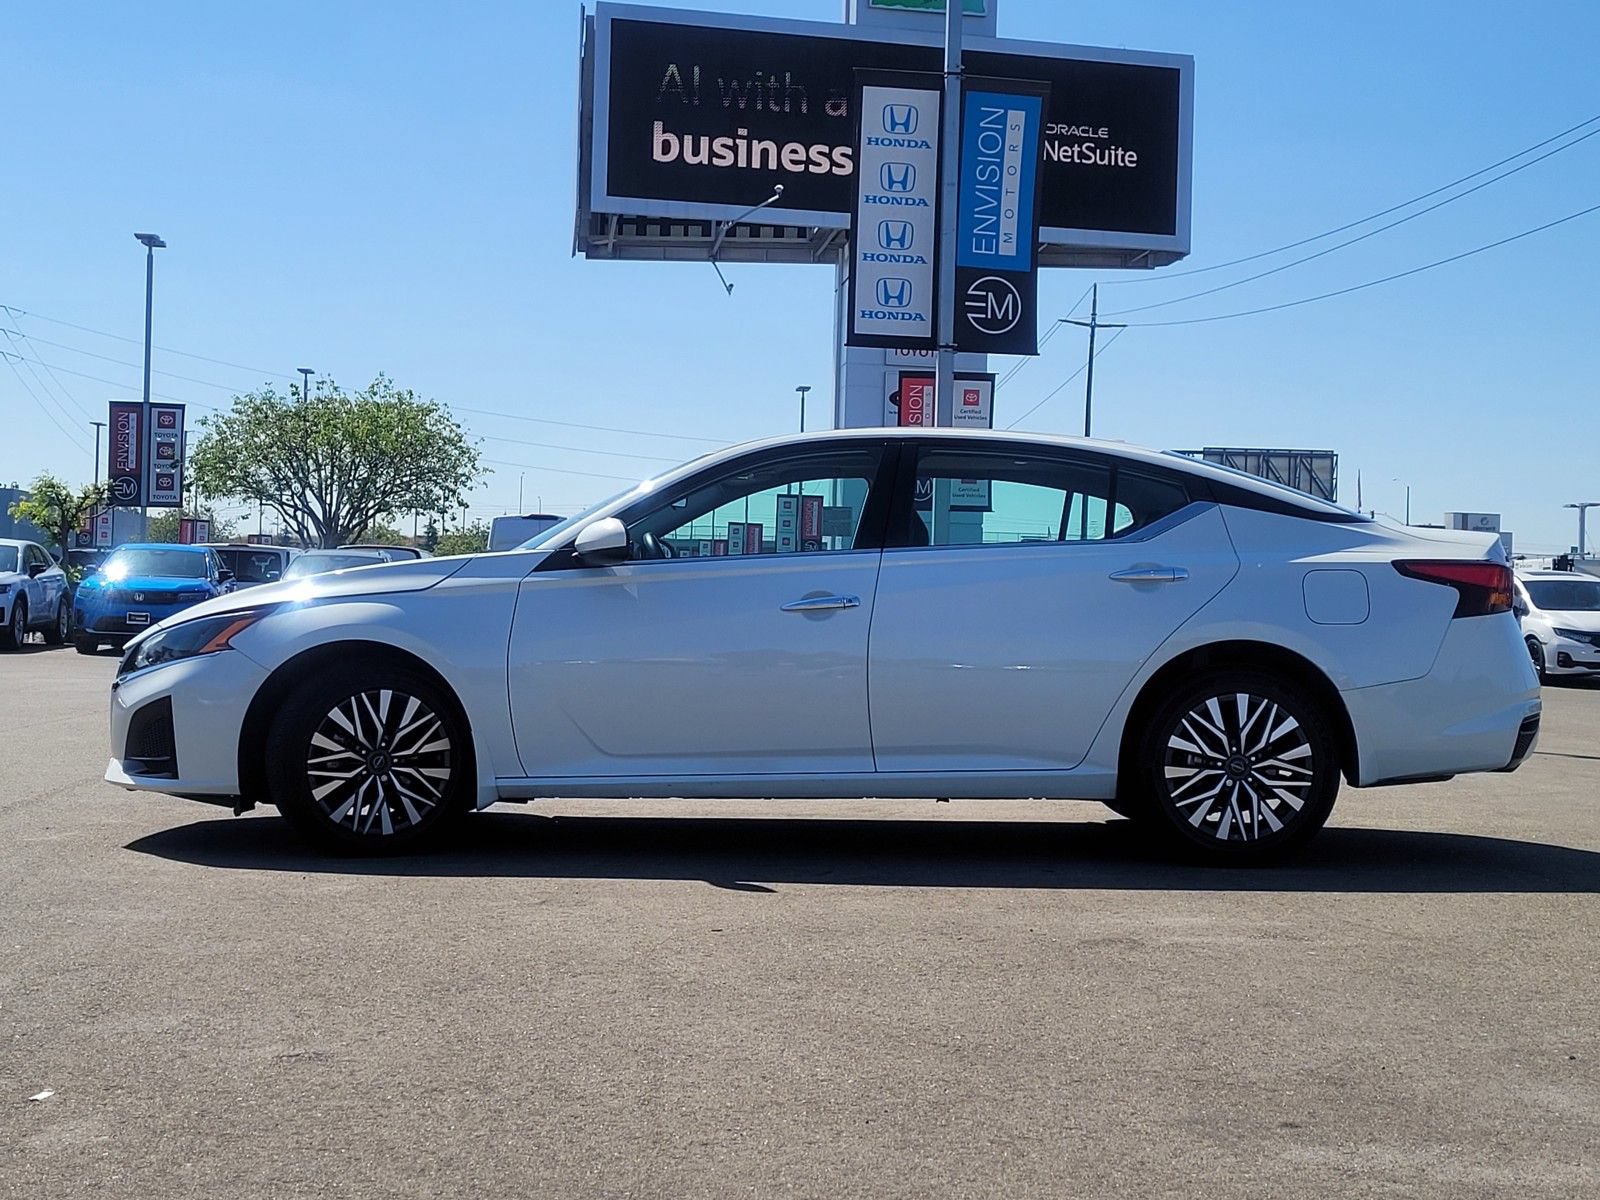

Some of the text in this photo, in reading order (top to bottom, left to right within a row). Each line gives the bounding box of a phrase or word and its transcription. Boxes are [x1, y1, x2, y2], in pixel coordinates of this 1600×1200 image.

[656, 63, 848, 117] AI with a
[866, 136, 932, 149] HONDA
[1044, 123, 1109, 139] ORACLE
[651, 121, 854, 176] business
[1043, 140, 1138, 167] NetSuite
[972, 107, 1005, 255] ENVISION
[1002, 123, 1021, 244] MOTORS
[864, 194, 930, 207] HONDA
[861, 252, 928, 265] HONDA
[860, 310, 927, 322] HONDA
[116, 412, 129, 469] ENVISION
